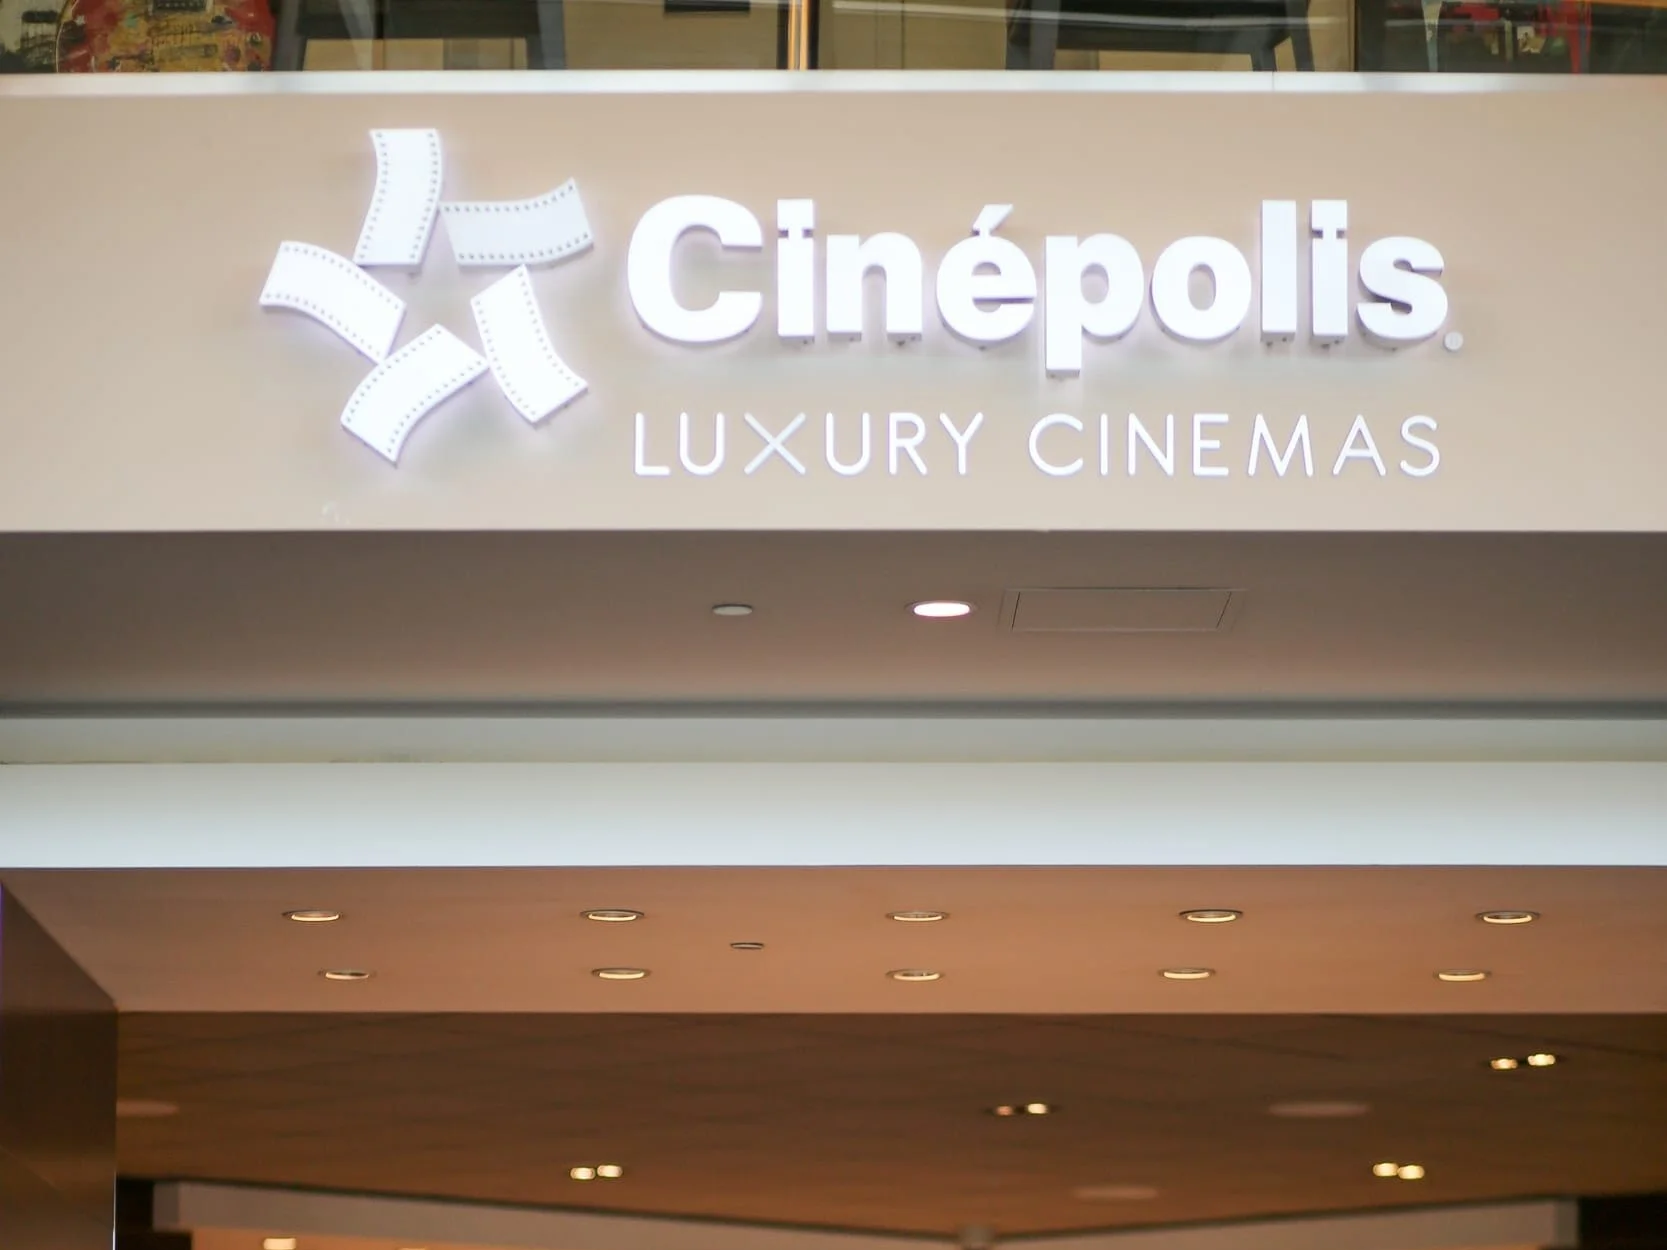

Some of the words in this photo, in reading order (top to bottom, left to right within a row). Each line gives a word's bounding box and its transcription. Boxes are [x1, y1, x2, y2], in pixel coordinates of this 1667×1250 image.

[627, 194, 1449, 377] Cinépolis
[634, 411, 984, 477] LUXURY
[1028, 411, 1441, 478] CINEMAS
